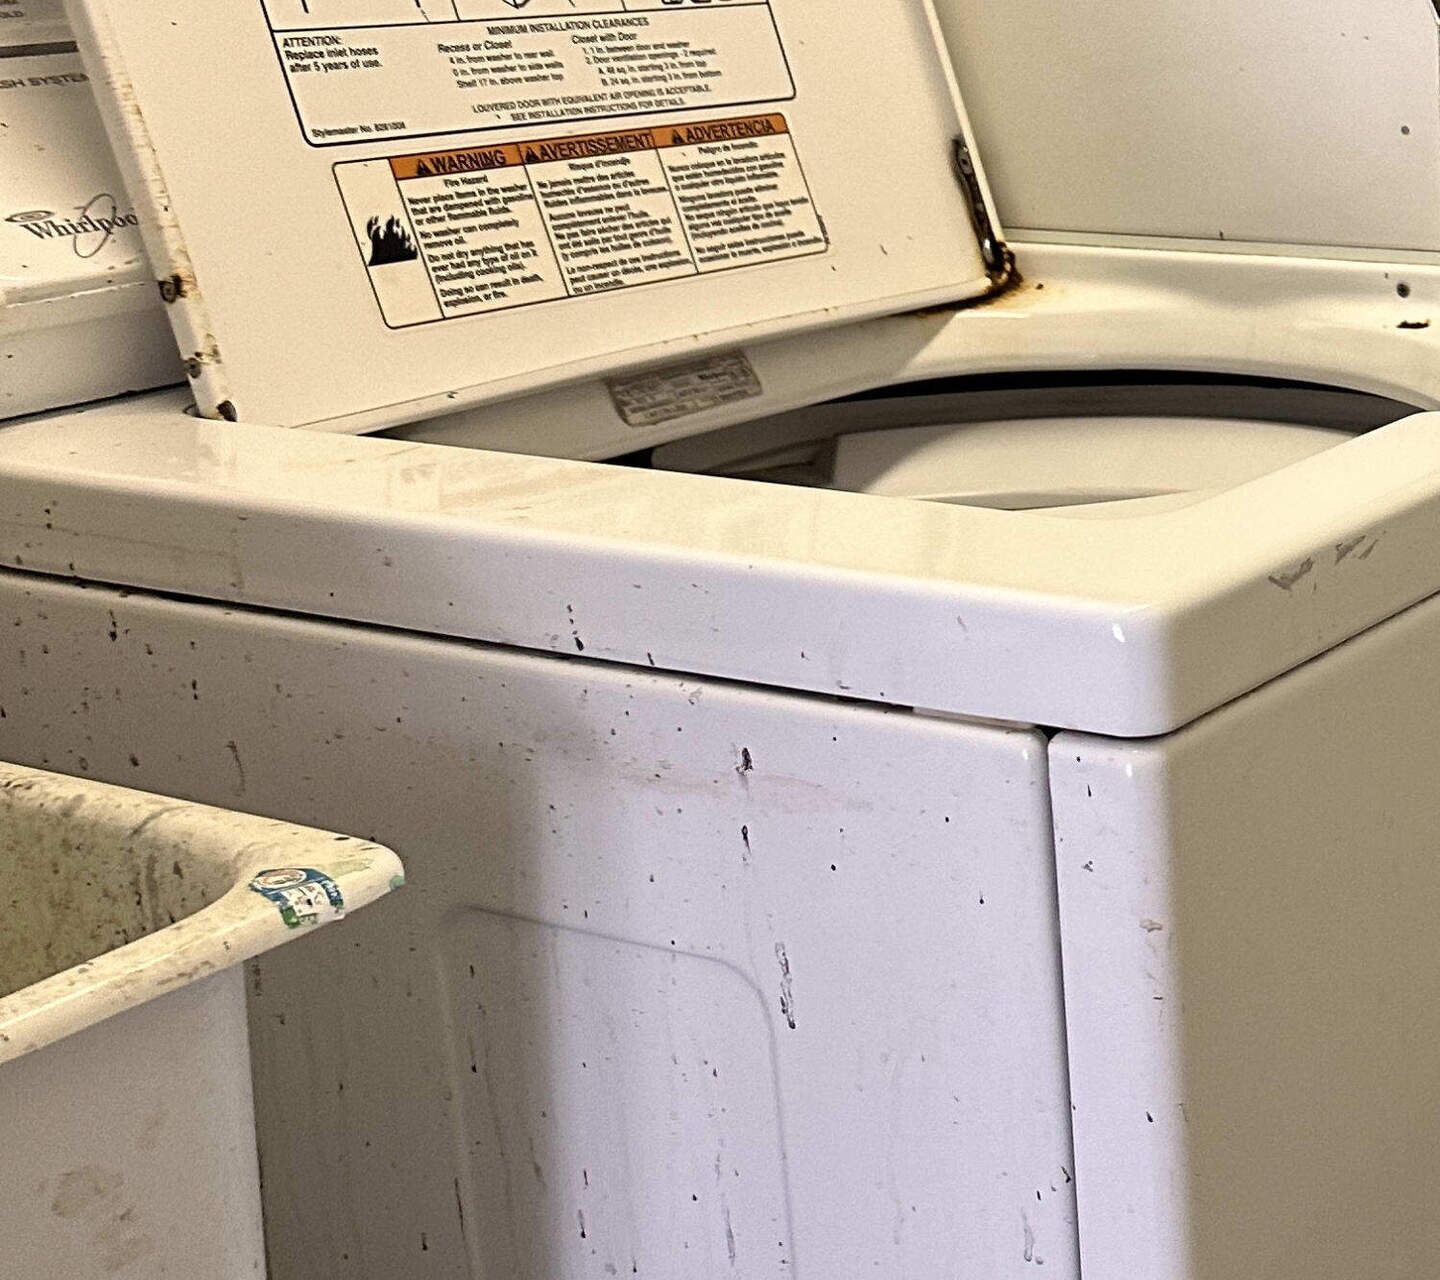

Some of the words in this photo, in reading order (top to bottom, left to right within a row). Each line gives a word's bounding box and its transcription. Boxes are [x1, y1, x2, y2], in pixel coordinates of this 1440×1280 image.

[529, 21, 592, 33] INSTALLATION
[592, 17, 650, 29] CLEARANCES
[283, 35, 343, 48] ATTENTION:
[572, 34, 599, 44] Closet
[618, 32, 638, 41] Door
[284, 50, 325, 61] Replace
[327, 48, 348, 58] inlet
[348, 47, 379, 57] hoses
[290, 62, 311, 73] after
[313, 62, 321, 72] 5
[321, 60, 349, 73] years
[350, 59, 360, 69] of
[473, 101, 517, 114] LOUVERED
[517, 99, 541, 109] DOOR
[528, 107, 582, 119] INSTALLATION
[583, 102, 640, 115] INSTRUCTIONS
[686, 119, 776, 142] ADVERTENCIA
[540, 132, 653, 160] AVERTISSEMENT
[430, 149, 506, 174] WARNING
[19, 212, 138, 240] Whirlpoo
